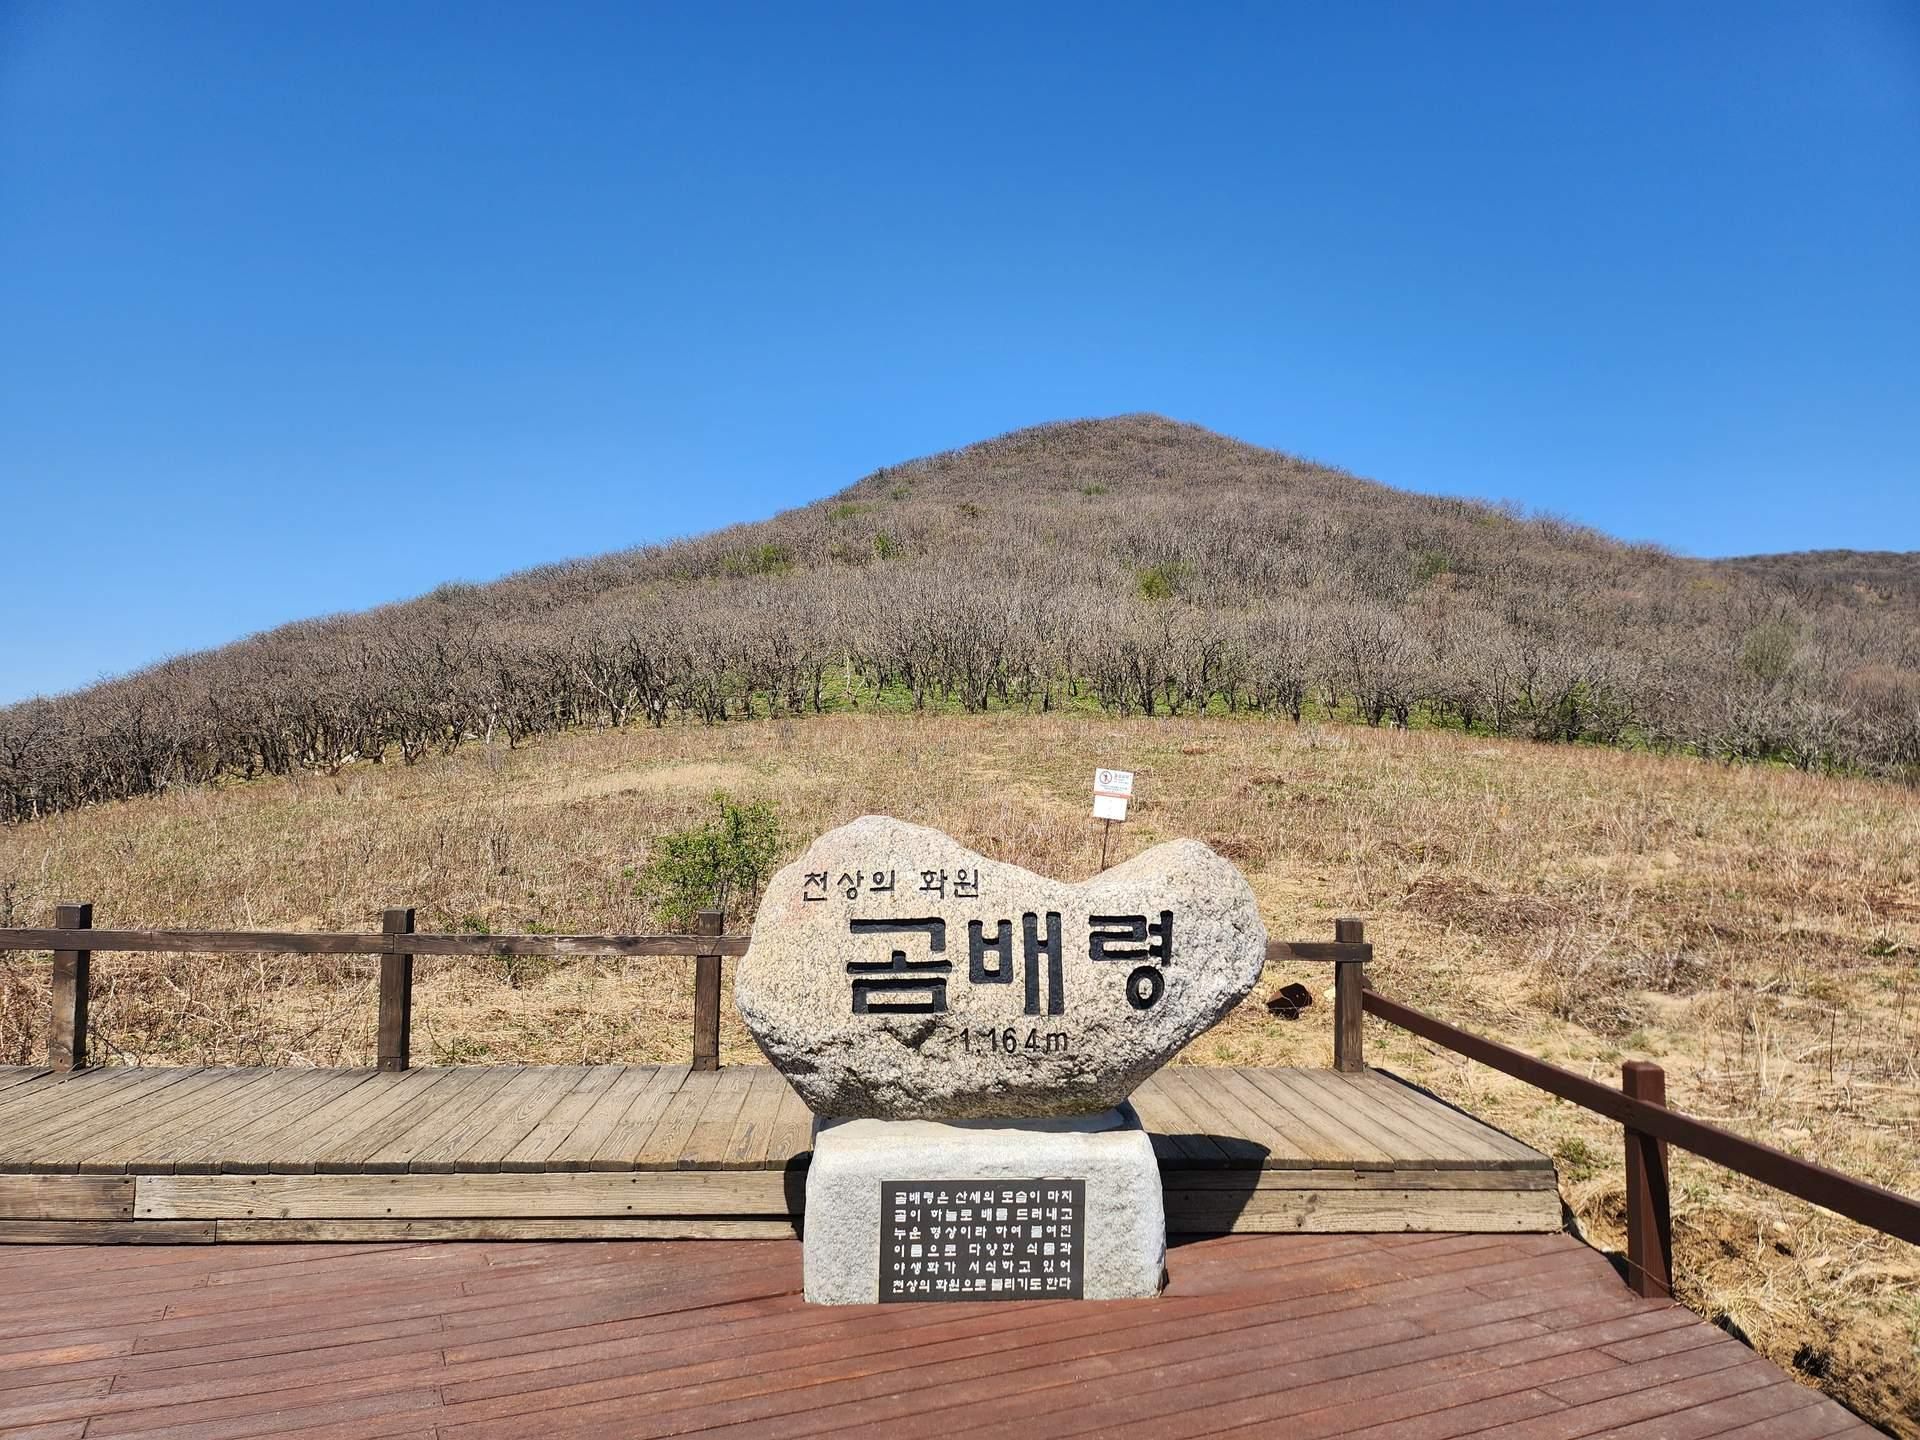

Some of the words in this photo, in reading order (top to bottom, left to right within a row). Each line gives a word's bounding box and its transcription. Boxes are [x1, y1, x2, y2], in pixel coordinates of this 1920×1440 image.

[803, 869, 895, 901] 천상의
[919, 868, 979, 900] 화원
[846, 910, 1173, 1016] 곰배령
[895, 1191, 949, 1205] 곰배령은
[955, 1190, 994, 1204] 산세의
[1001, 1190, 1040, 1204] 모습이
[894, 1209, 921, 1222] 곰이
[930, 1208, 973, 1222] 하늘로
[1016, 1207, 1072, 1221] 드러내고
[894, 1226, 921, 1240] 누운
[930, 1226, 987, 1240] 형상이라
[995, 1225, 1021, 1239] 하여
[894, 1244, 957, 1258] 이름으로
[968, 1242, 1015, 1256] 다양한
[893, 1261, 957, 1275] 야생화가
[968, 1260, 1031, 1274] 서식하고
[1043, 1259, 1071, 1273] 있어
[892, 1279, 930, 1293] 천상의
[935, 1278, 987, 1292] 화원으로
[1046, 1277, 1072, 1291] 한다
